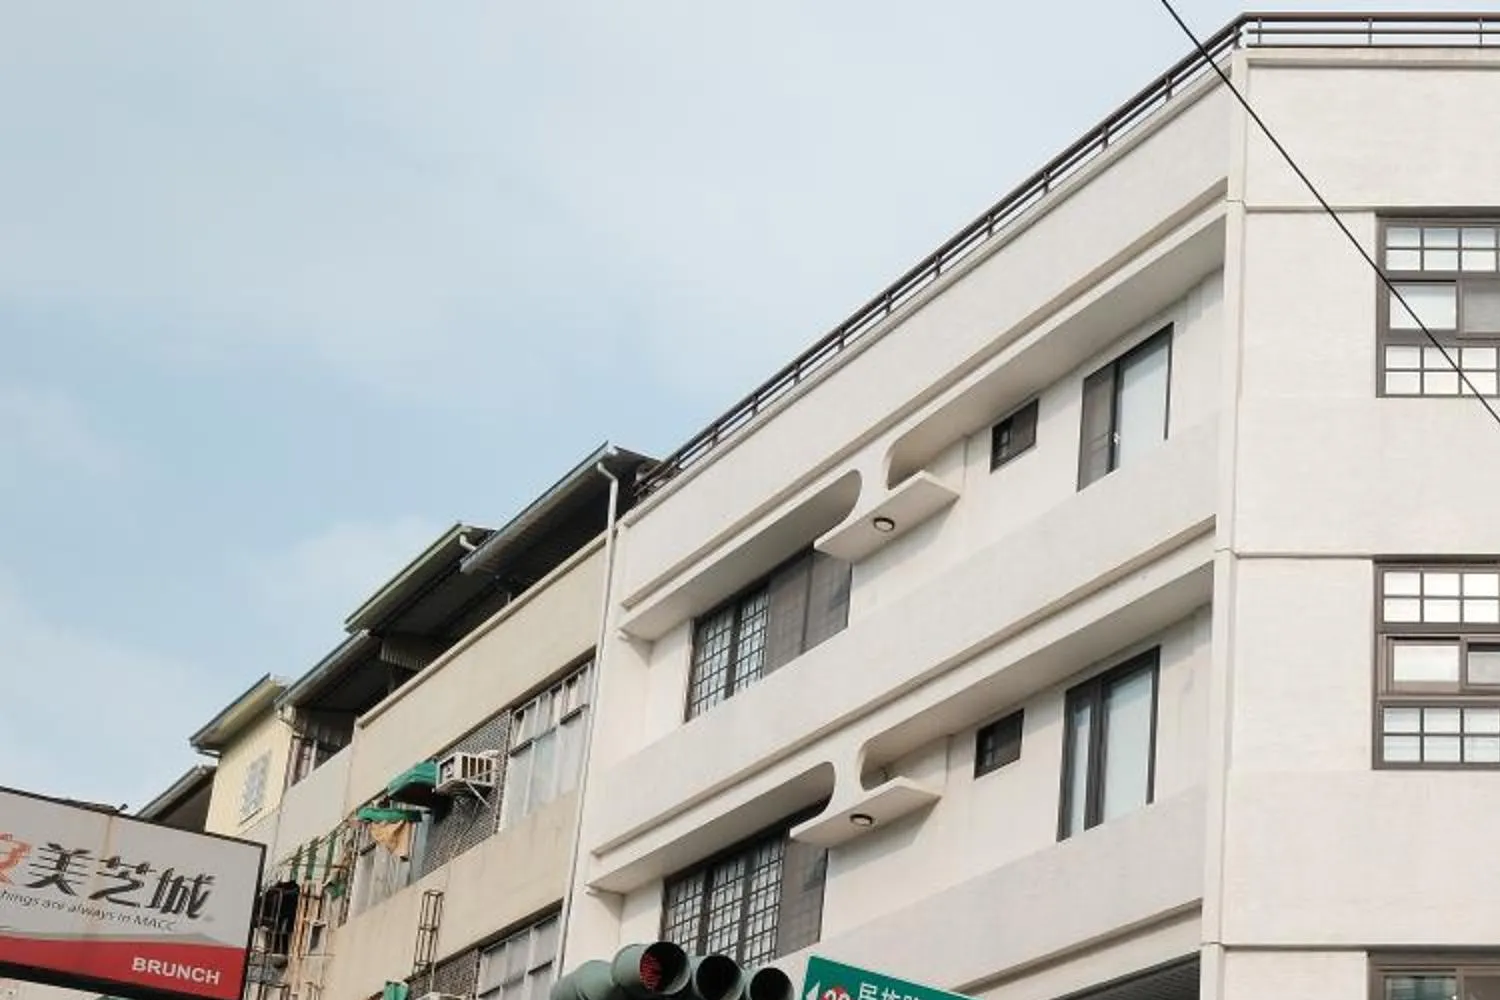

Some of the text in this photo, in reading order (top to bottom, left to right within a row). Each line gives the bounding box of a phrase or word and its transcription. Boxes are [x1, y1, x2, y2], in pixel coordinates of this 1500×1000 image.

[25, 842, 215, 920] 美芝城
[132, 957, 220, 985] BRUNCH
